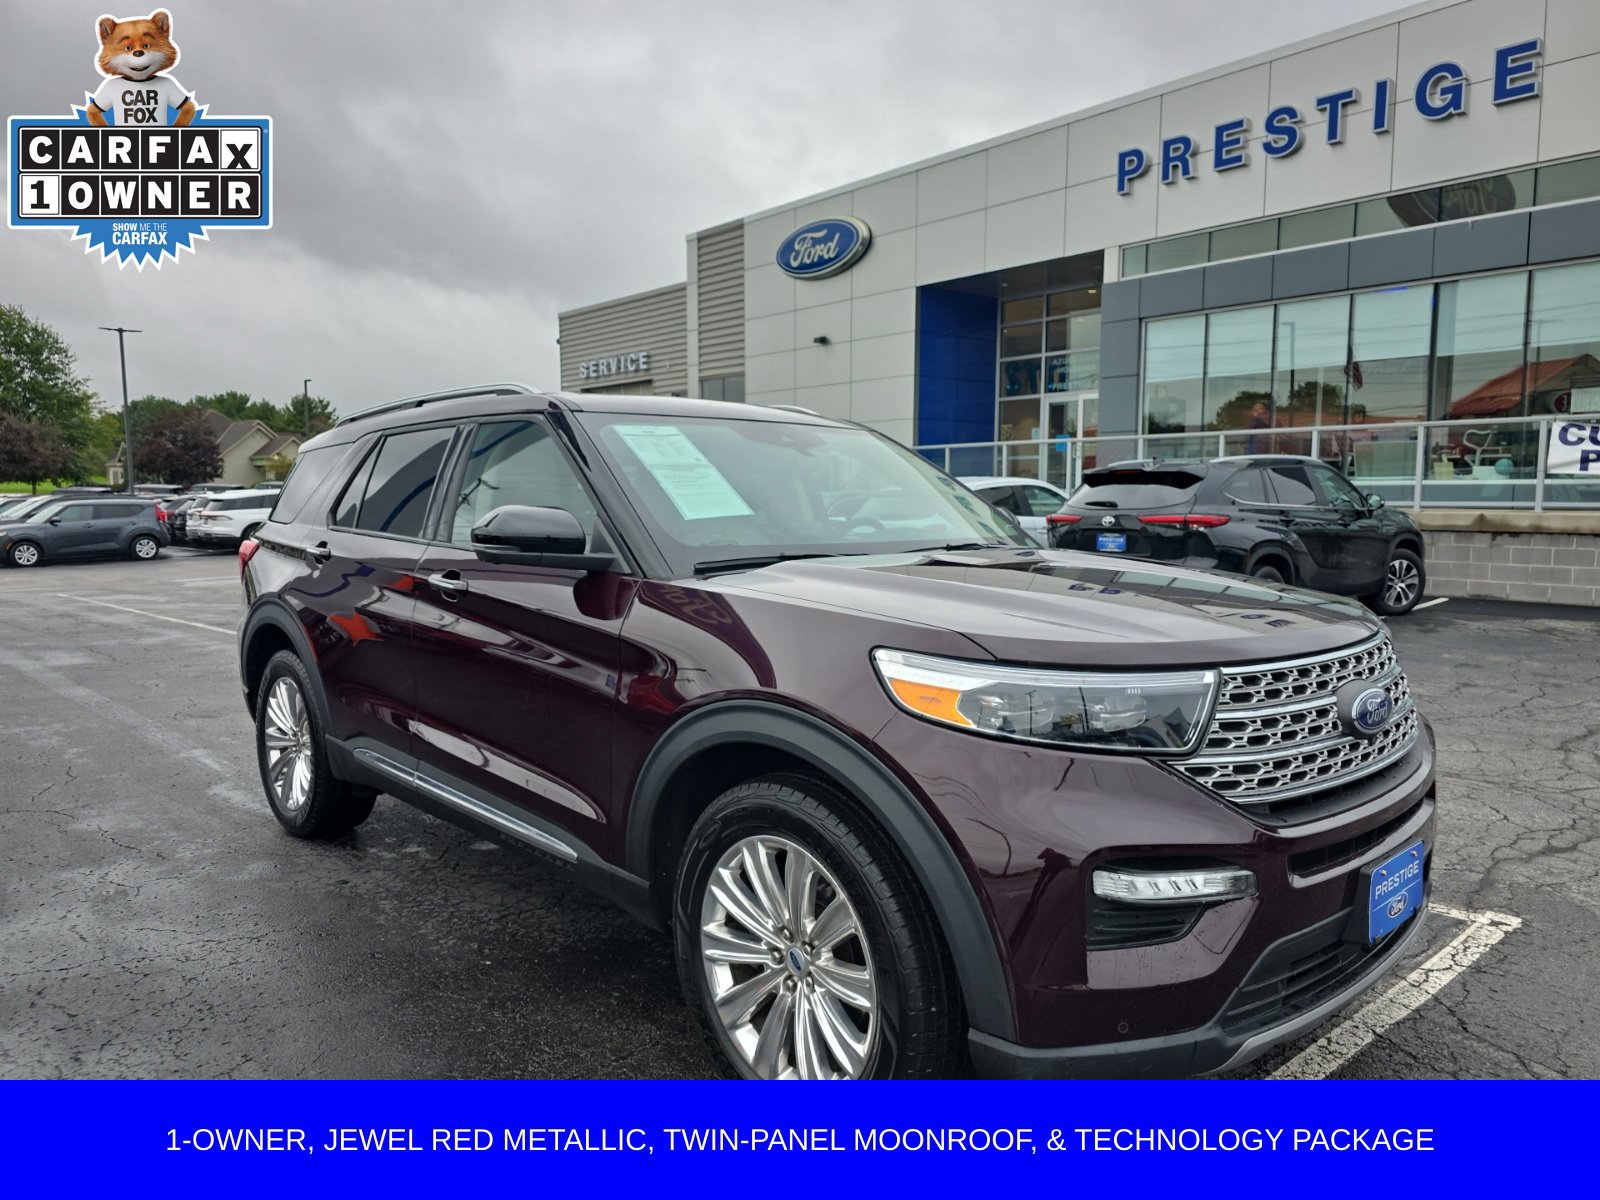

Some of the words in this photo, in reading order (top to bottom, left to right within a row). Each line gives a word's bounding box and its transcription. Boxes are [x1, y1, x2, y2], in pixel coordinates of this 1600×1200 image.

[1116, 37, 1543, 196] PRESTIGE
[789, 228, 841, 268] Ford
[579, 352, 649, 378] SERVICE
[1366, 697, 1389, 724] Ford
[1375, 860, 1420, 900] PRESTIGE
